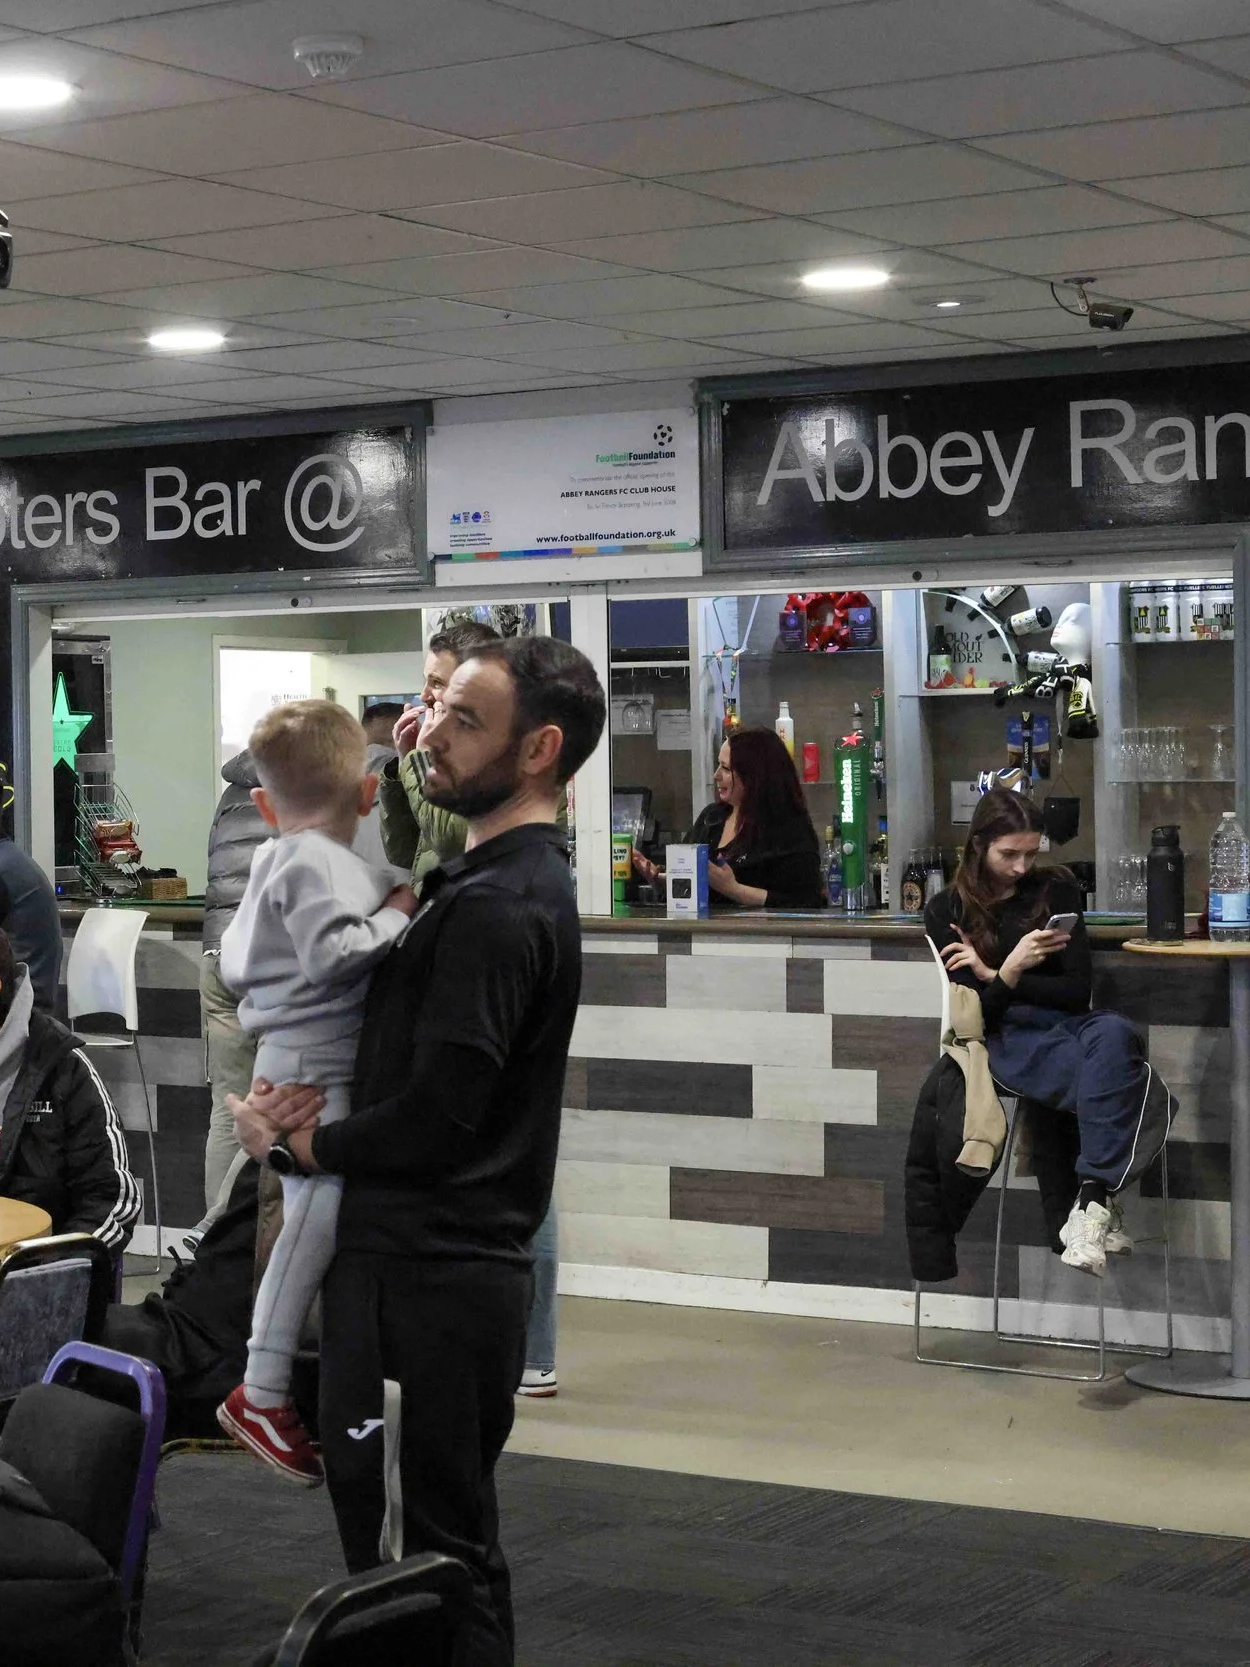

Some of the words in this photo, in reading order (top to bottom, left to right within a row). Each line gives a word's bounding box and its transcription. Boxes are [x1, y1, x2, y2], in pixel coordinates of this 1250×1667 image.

[755, 414, 1036, 517] Abbey
[1069, 398, 1250, 488] Ran
[145, 466, 262, 541] Bar
[283, 453, 366, 552] @
[560, 491, 583, 499] ABBEY
[536, 528, 676, 544] www.footballfoundation.org.uk
[953, 651, 983, 664] IDER
[840, 758, 854, 824] Heineken
[853, 759, 862, 796] ORIGINAL
